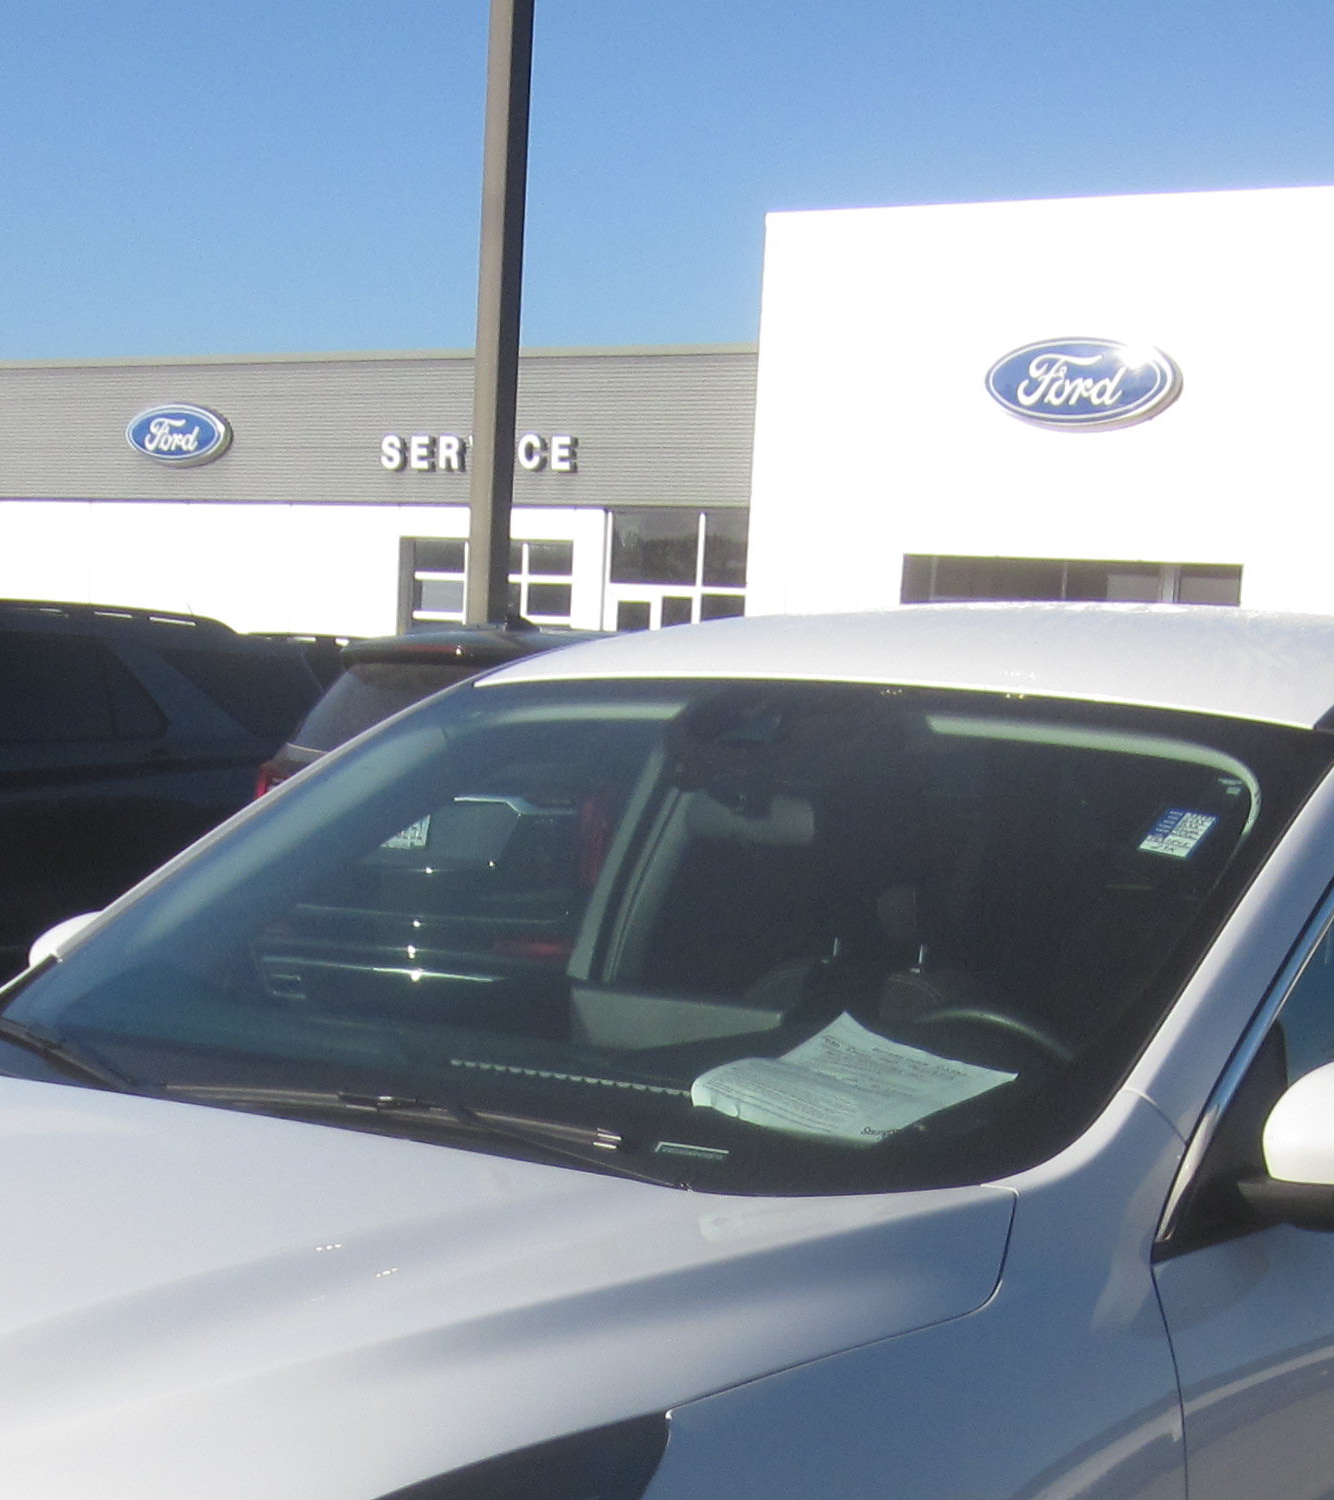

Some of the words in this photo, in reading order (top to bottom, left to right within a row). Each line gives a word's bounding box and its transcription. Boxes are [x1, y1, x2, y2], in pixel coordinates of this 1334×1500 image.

[1017, 353, 1127, 406] Ford
[144, 417, 201, 451] Ford
[381, 433, 576, 472] SERCE
